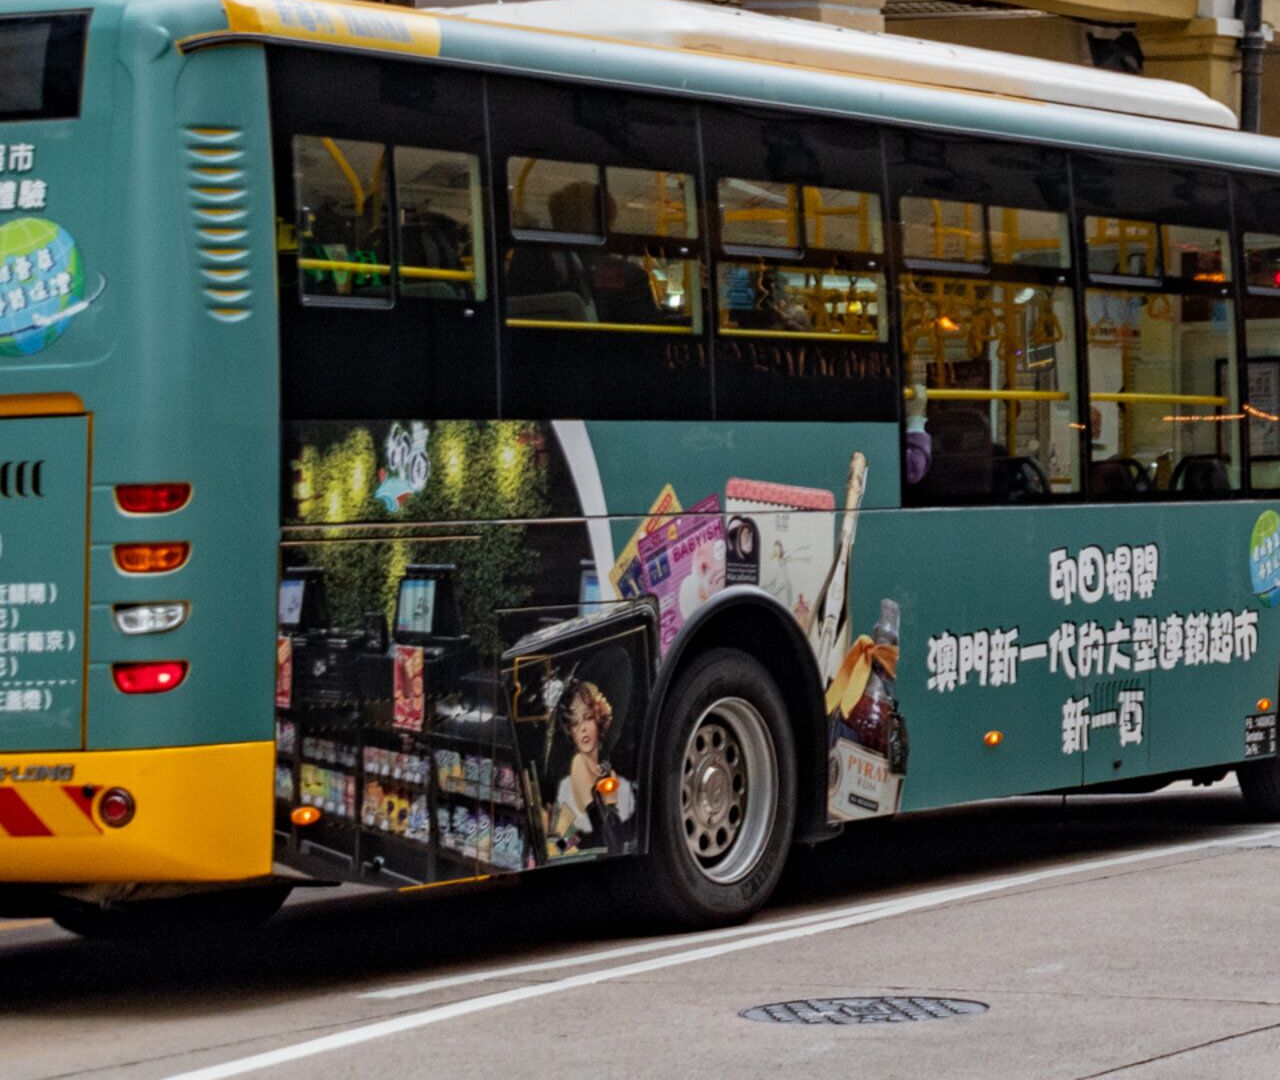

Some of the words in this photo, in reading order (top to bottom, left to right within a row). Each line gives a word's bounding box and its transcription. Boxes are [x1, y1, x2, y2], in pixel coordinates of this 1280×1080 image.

[673, 521, 724, 563] BABYISH
[927, 609, 1258, 693] 澳門新一代的大型連鎖超市
